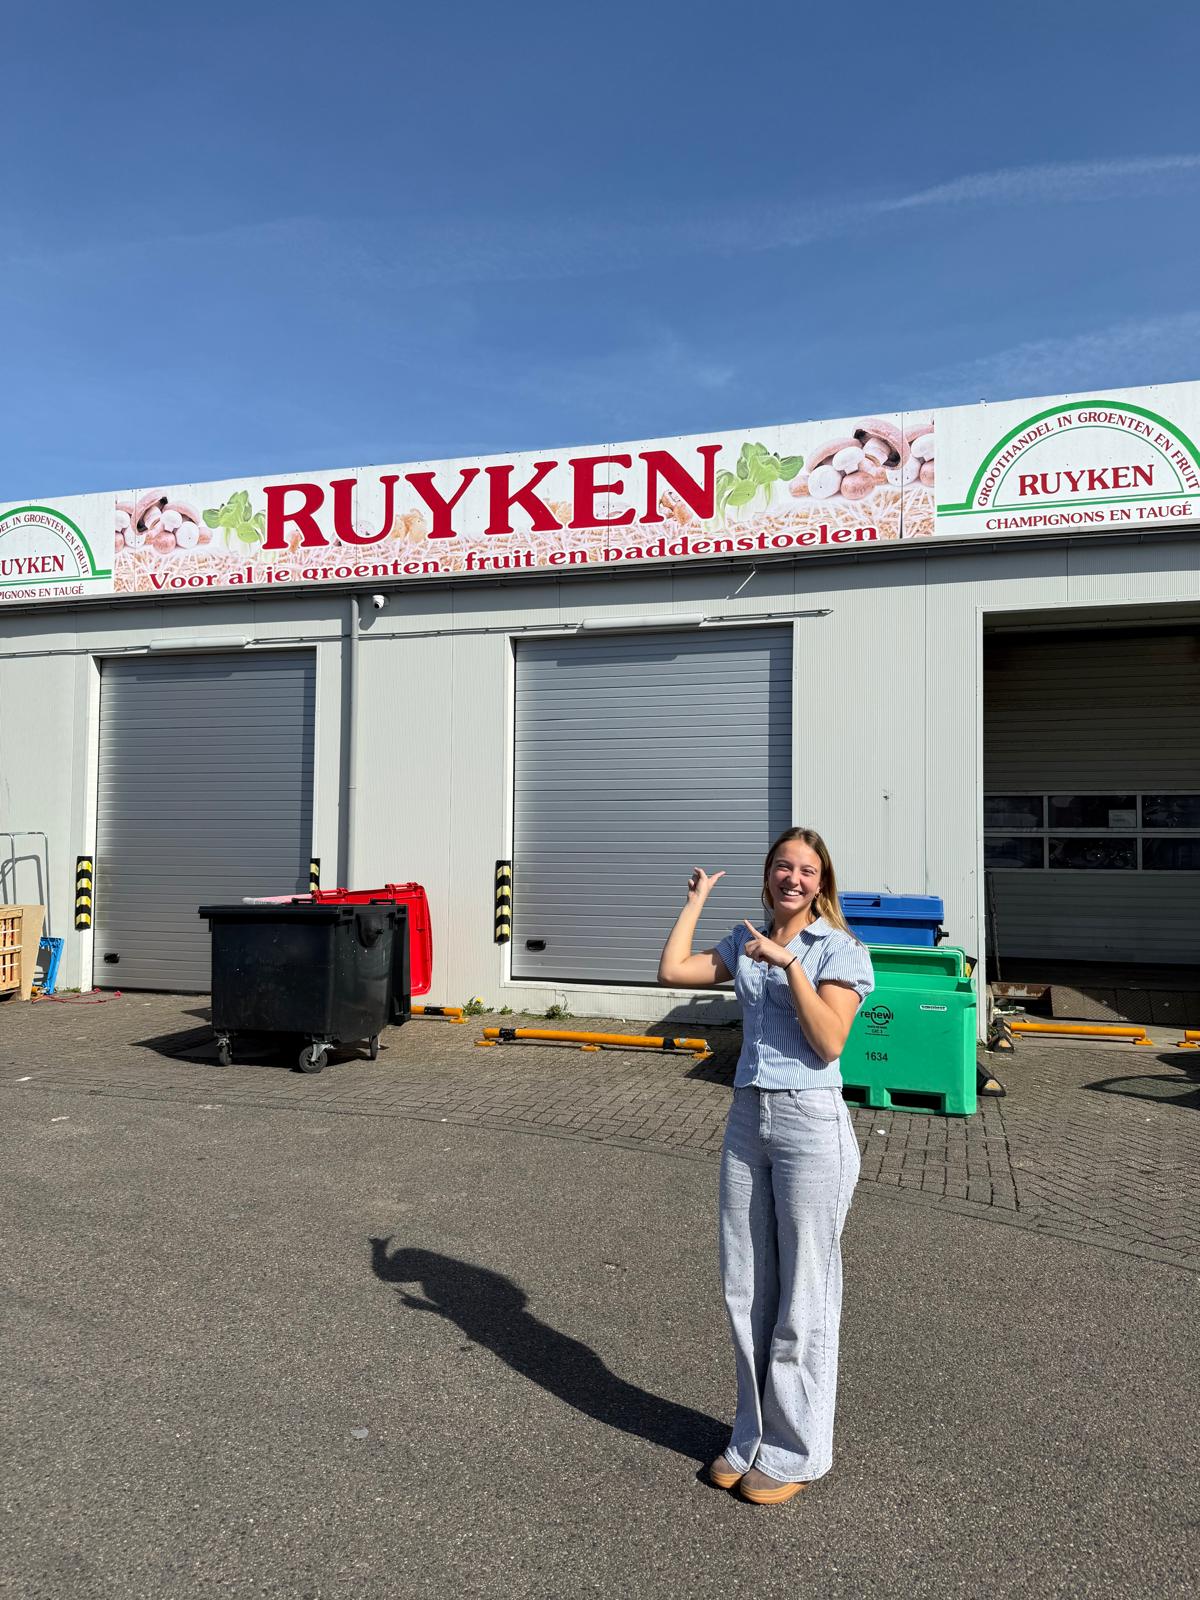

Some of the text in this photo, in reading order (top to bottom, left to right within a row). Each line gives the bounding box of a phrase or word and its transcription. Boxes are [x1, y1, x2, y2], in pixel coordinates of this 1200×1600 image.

[977, 411, 1200, 507] GROOTHANDEL IN GROENTEN EN FRUIT
[1018, 464, 1155, 496] RUYKEN
[262, 444, 723, 550] RUYKEN
[985, 501, 1193, 530] CHAMPIGNONS EN TAUGÉ
[13, 516, 21, 526] IN
[24, 514, 66, 534] GROENTEN
[65, 532, 76, 545] EN
[74, 545, 89, 575] FRUIT
[149, 572, 218, 590] Voor
[228, 566, 253, 585] al
[464, 550, 535, 571] fruit
[549, 551, 588, 565] en
[603, 524, 878, 562] paddenstoelen
[0, 555, 65, 576] UYKEN
[39, 588, 51, 597] EN
[53, 584, 84, 596] TAUGÉ
[865, 1051, 888, 1062] 1634
